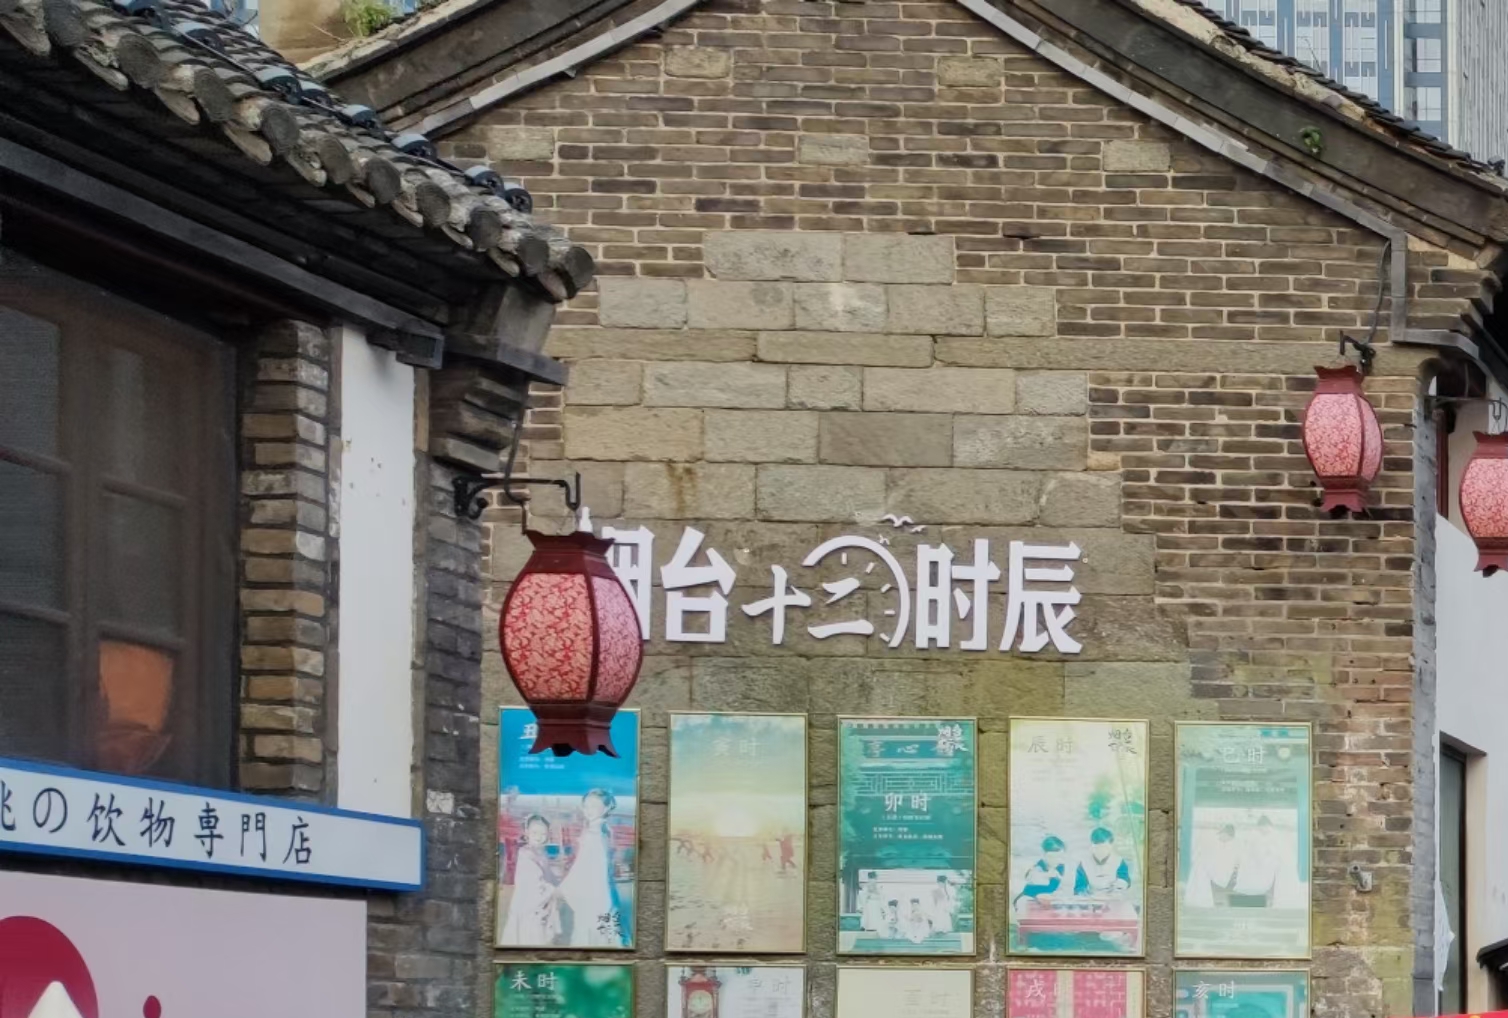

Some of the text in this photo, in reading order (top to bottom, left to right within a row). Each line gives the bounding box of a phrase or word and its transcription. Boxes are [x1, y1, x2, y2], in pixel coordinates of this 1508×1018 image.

[1027, 737, 1072, 753] 辰时
[885, 793, 930, 812] 卯时
[511, 972, 557, 991] 未时
[1193, 980, 1235, 999] 亥时
